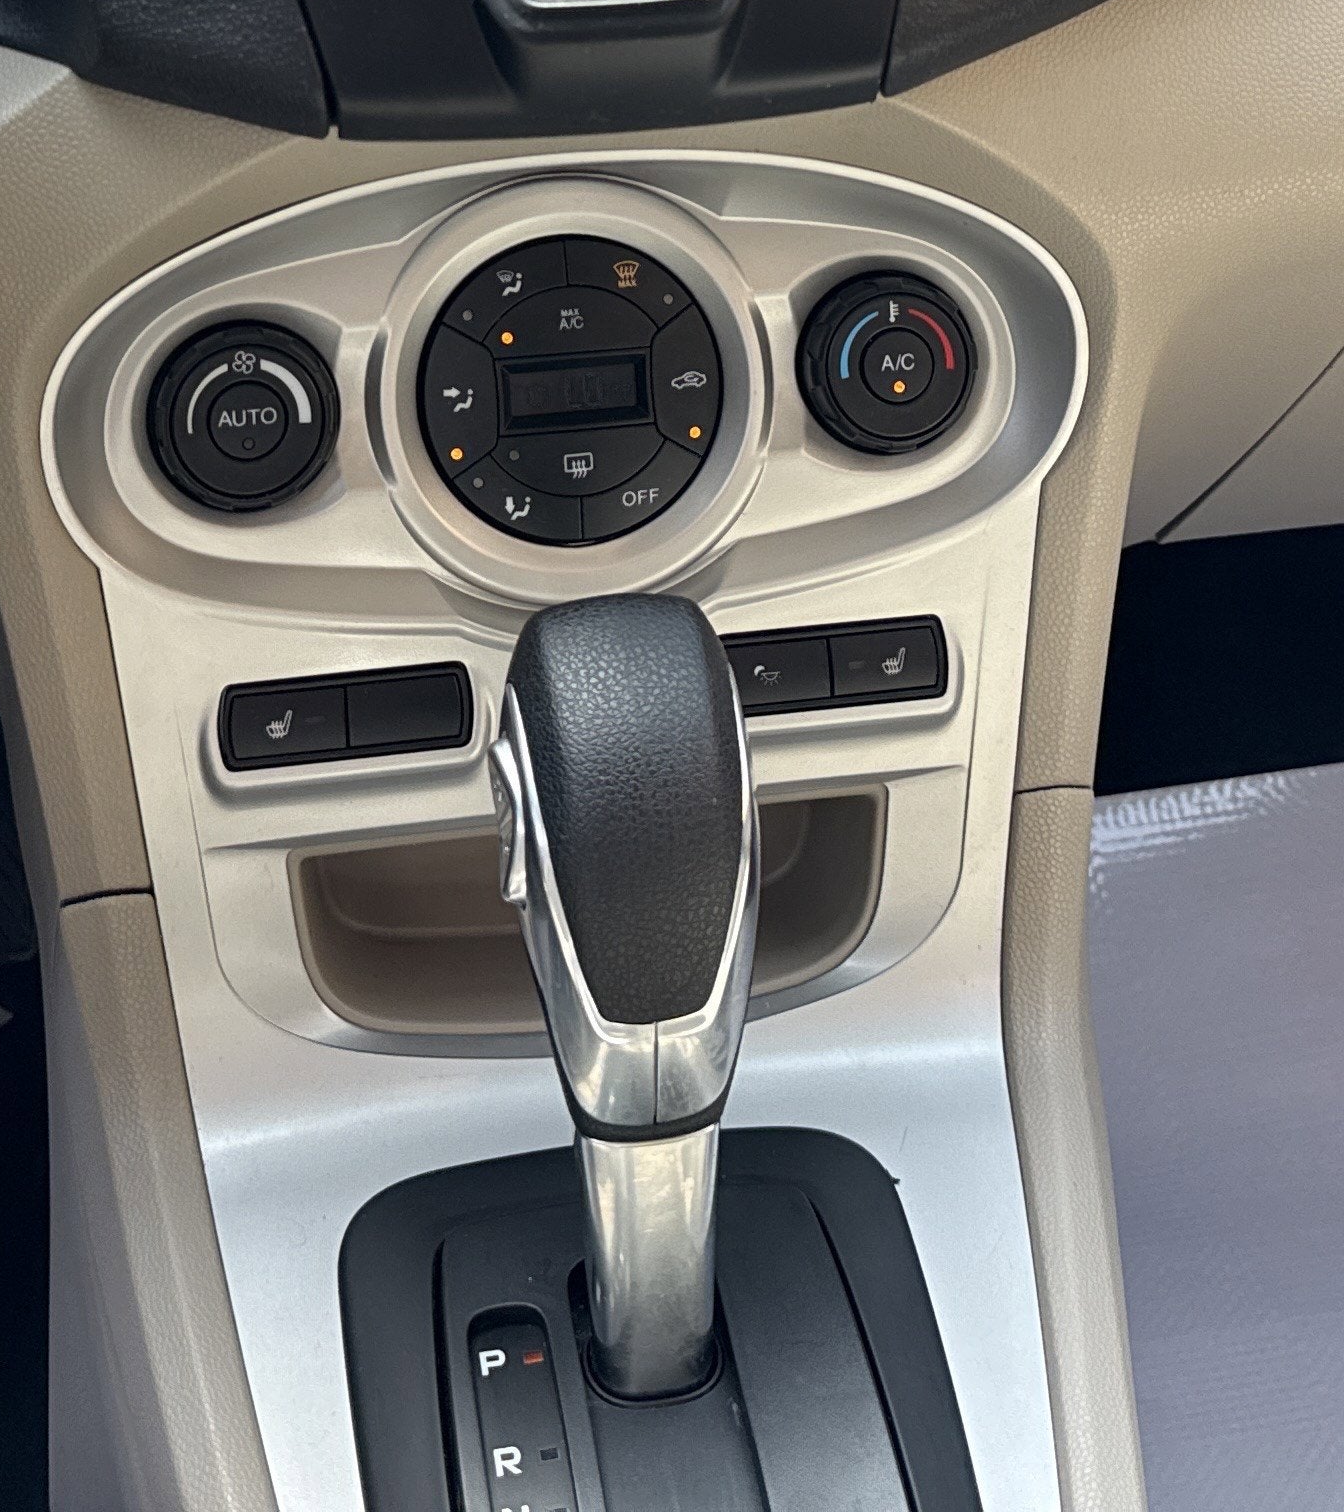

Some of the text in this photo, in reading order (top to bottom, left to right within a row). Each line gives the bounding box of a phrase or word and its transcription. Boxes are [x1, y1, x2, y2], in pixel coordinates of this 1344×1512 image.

[560, 309, 580, 317] MAX
[559, 316, 584, 330] A/C
[881, 353, 915, 372] A/C
[218, 407, 278, 427] AUTO
[622, 488, 660, 507] OFF
[478, 1349, 507, 1377] P
[493, 1445, 523, 1478] R
